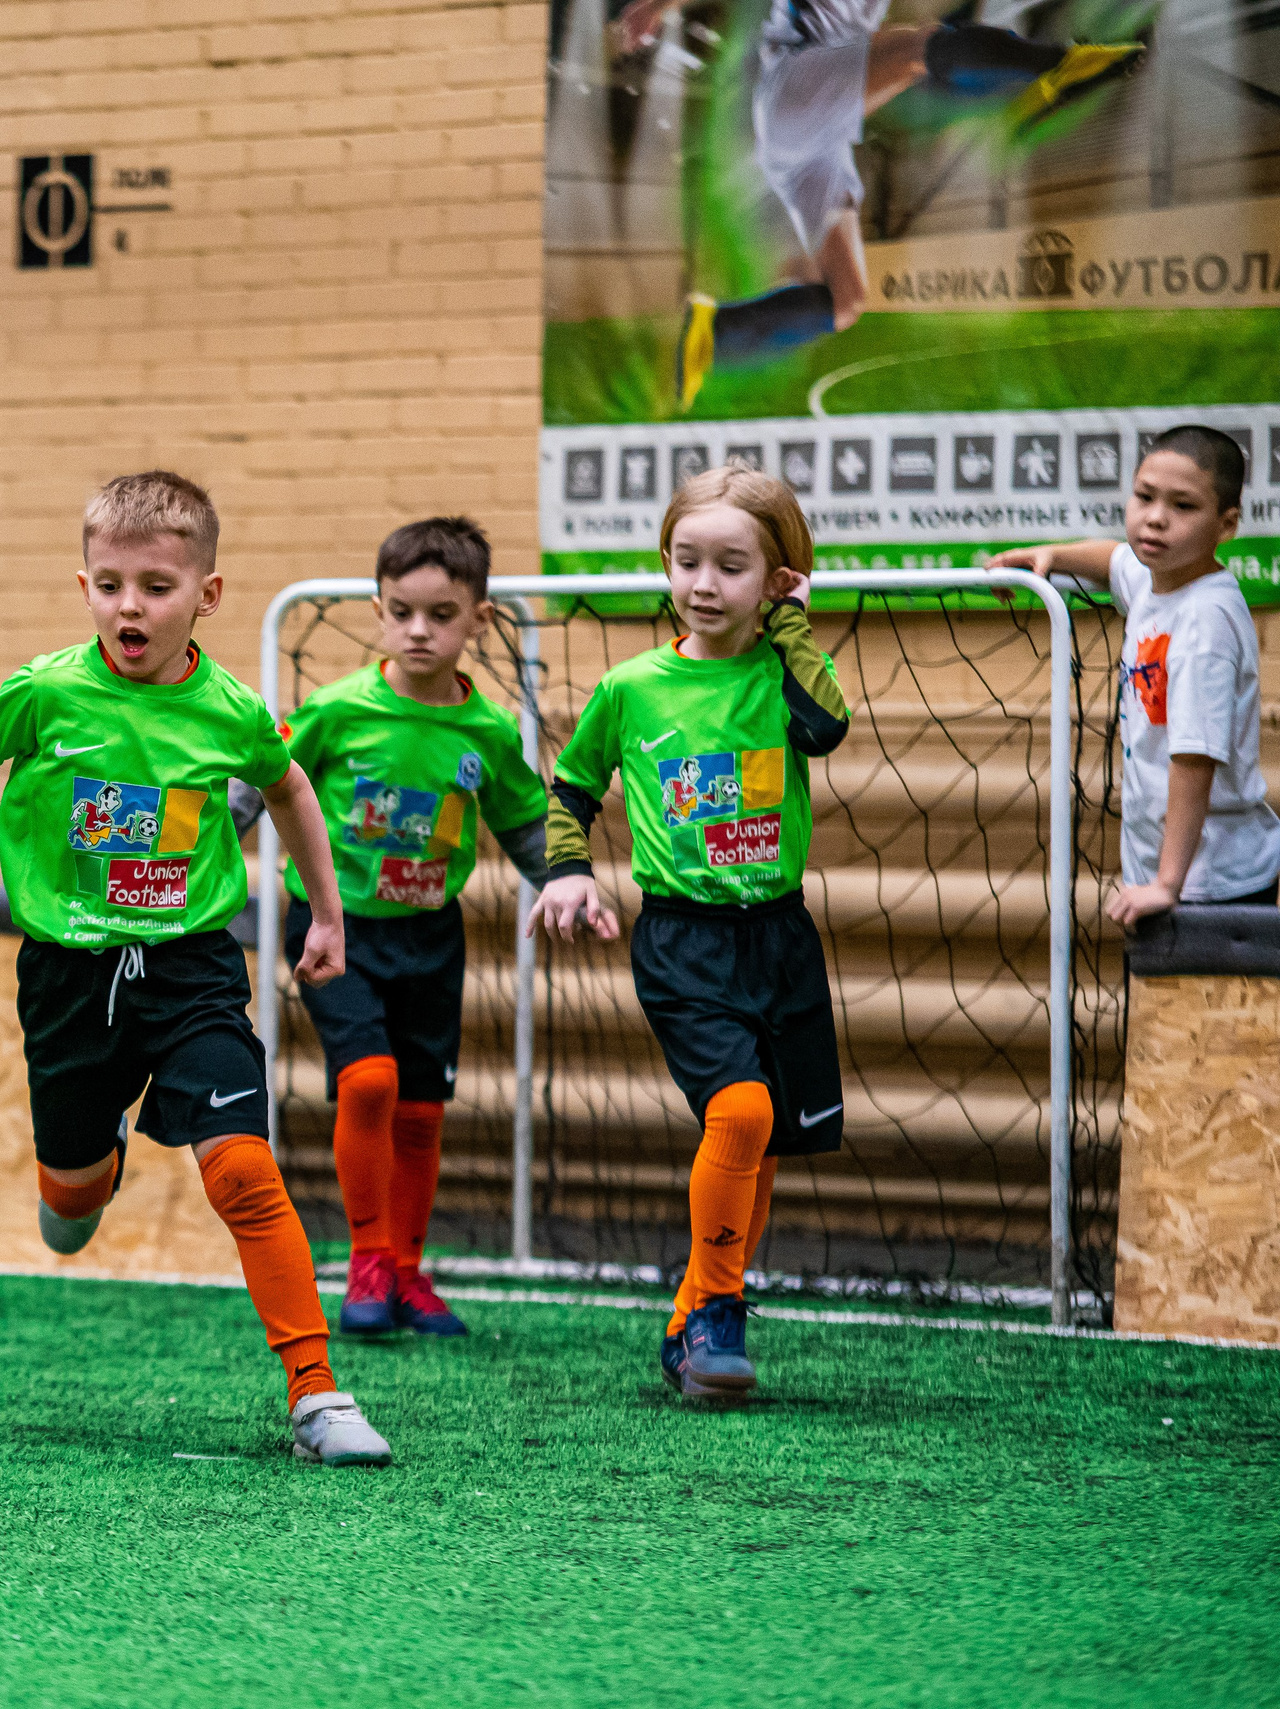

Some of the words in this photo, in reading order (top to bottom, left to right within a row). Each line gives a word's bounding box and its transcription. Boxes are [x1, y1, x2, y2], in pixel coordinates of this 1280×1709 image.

[1078, 251, 1280, 298] ФУТБОЛ
[726, 817, 780, 840] Junior
[707, 840, 780, 866] Footballer
[134, 859, 187, 880] Junior
[106, 879, 187, 907] Footballer
